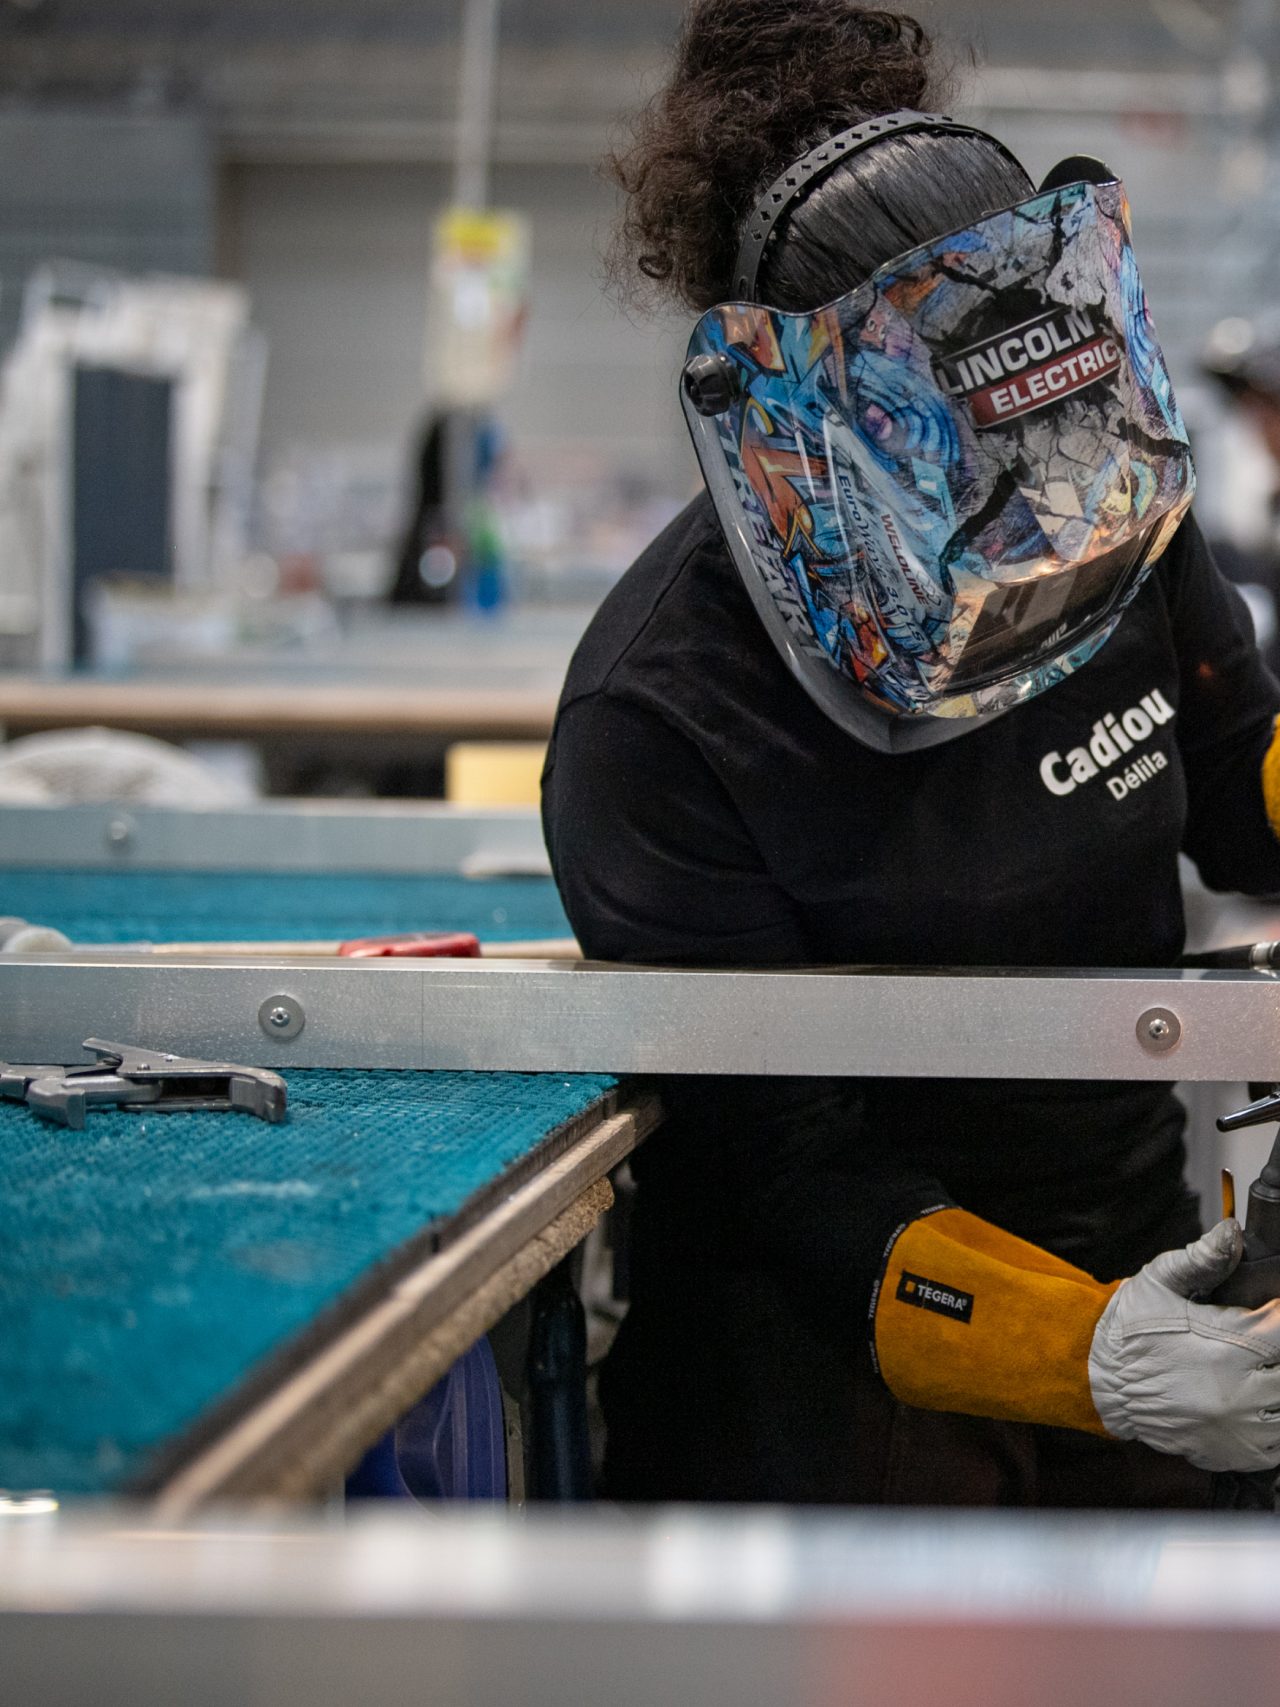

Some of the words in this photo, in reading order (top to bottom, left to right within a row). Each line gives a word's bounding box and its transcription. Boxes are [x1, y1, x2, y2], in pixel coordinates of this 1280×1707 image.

[936, 309, 1096, 395] LINCOLN
[990, 338, 1120, 415] ELECTRIC
[881, 513, 930, 607] WELDLINE
[1040, 688, 1175, 796] Cadiou
[1106, 751, 1168, 801] Délila
